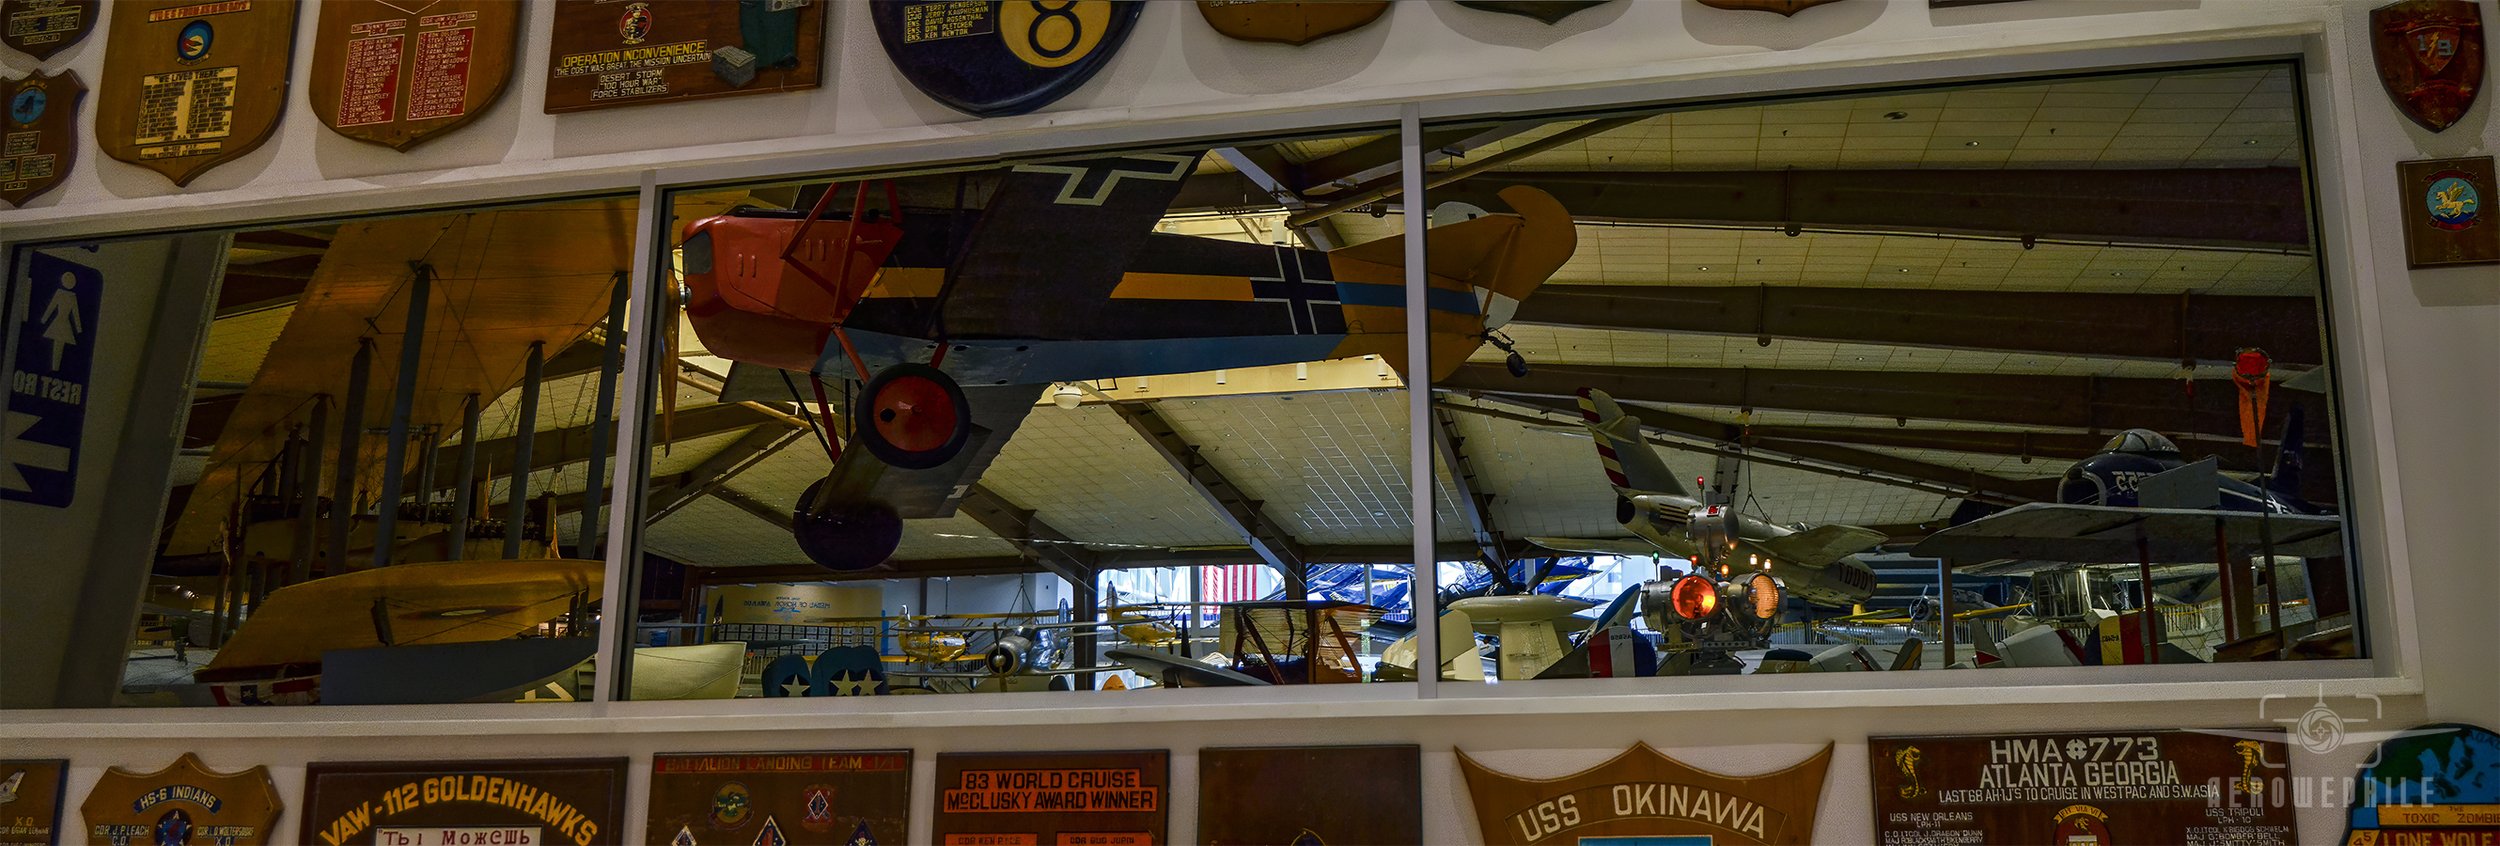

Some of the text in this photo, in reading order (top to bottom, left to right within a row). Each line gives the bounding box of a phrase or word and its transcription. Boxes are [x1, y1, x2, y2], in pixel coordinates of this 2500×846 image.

[563, 41, 706, 68] OPERATION INCONVENIENCE
[556, 67, 569, 76] THE
[571, 65, 589, 74] COST
[591, 63, 604, 72] WAS
[630, 60, 642, 68] THE
[644, 57, 670, 67] MISSION
[673, 52, 712, 64] UNCERTAIN
[600, 69, 663, 83] DESERT STORM
[619, 79, 640, 88] HOUR
[593, 84, 667, 99] FORCE STABILIZERS
[1990, 736, 2159, 764] HMA 773
[665, 758, 740, 772] BATTALION
[746, 758, 812, 771] LANDING
[822, 757, 862, 770] TEAM
[965, 771, 1136, 790] 83 WORLD CRUISE
[1979, 760, 2180, 789] ATLANTA GEORGIA
[172, 786, 216, 808] INDIANS
[1034, 791, 1087, 809] AWARD
[1091, 790, 1153, 809] WINNER
[1939, 789, 1968, 803] LAST
[2024, 787, 2038, 801] TO
[2040, 786, 2078, 800] CRUISE
[2081, 786, 2091, 799] IN
[2149, 785, 2170, 799] AND
[423, 775, 598, 846] GOLDENHAWKS
[1517, 783, 1765, 842] USS OKINAWA
[1890, 811, 1974, 822] USS NEW ORLEANS
[2205, 807, 2264, 817] USS TRIPOLI
[2403, 813, 2440, 824] TOXIC
[1070, 836, 1087, 844] CDR
